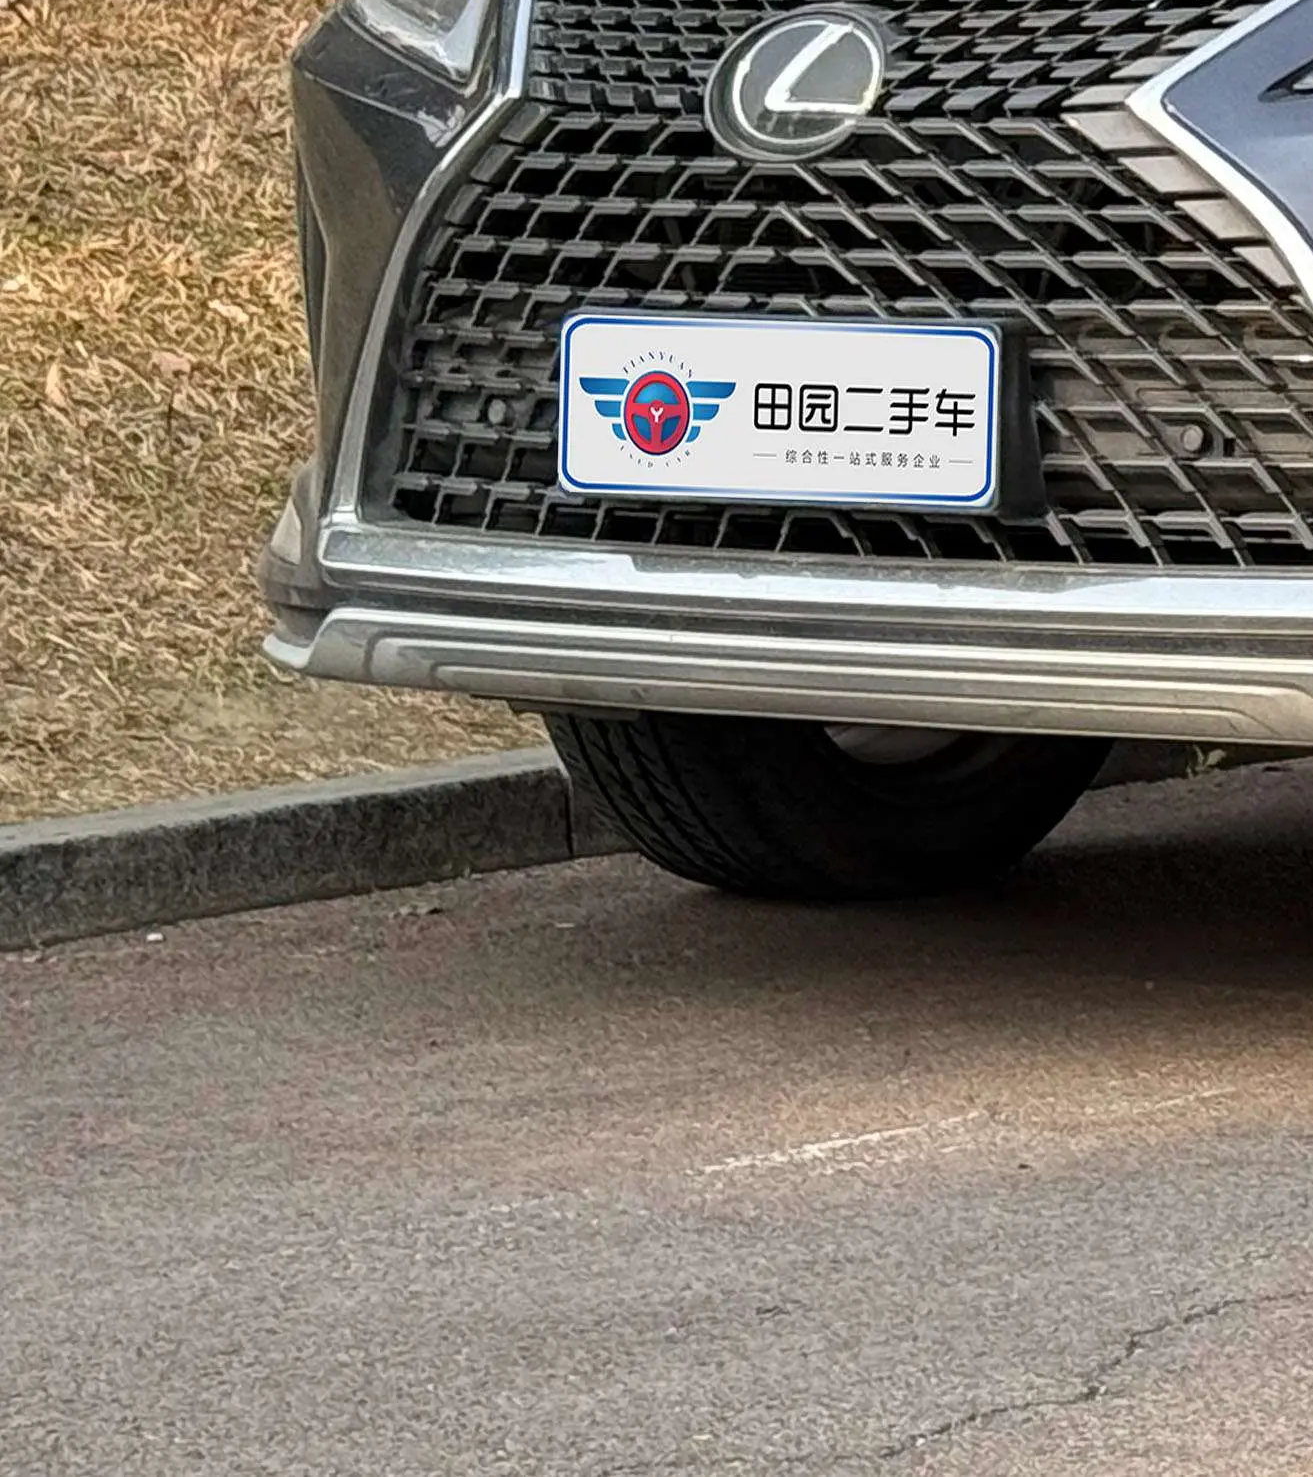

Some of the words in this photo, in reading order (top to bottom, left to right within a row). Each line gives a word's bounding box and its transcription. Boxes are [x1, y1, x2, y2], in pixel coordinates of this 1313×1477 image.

[754, 383, 976, 437] 田园二手车
[785, 449, 941, 469] 综合性一站式服务企业
